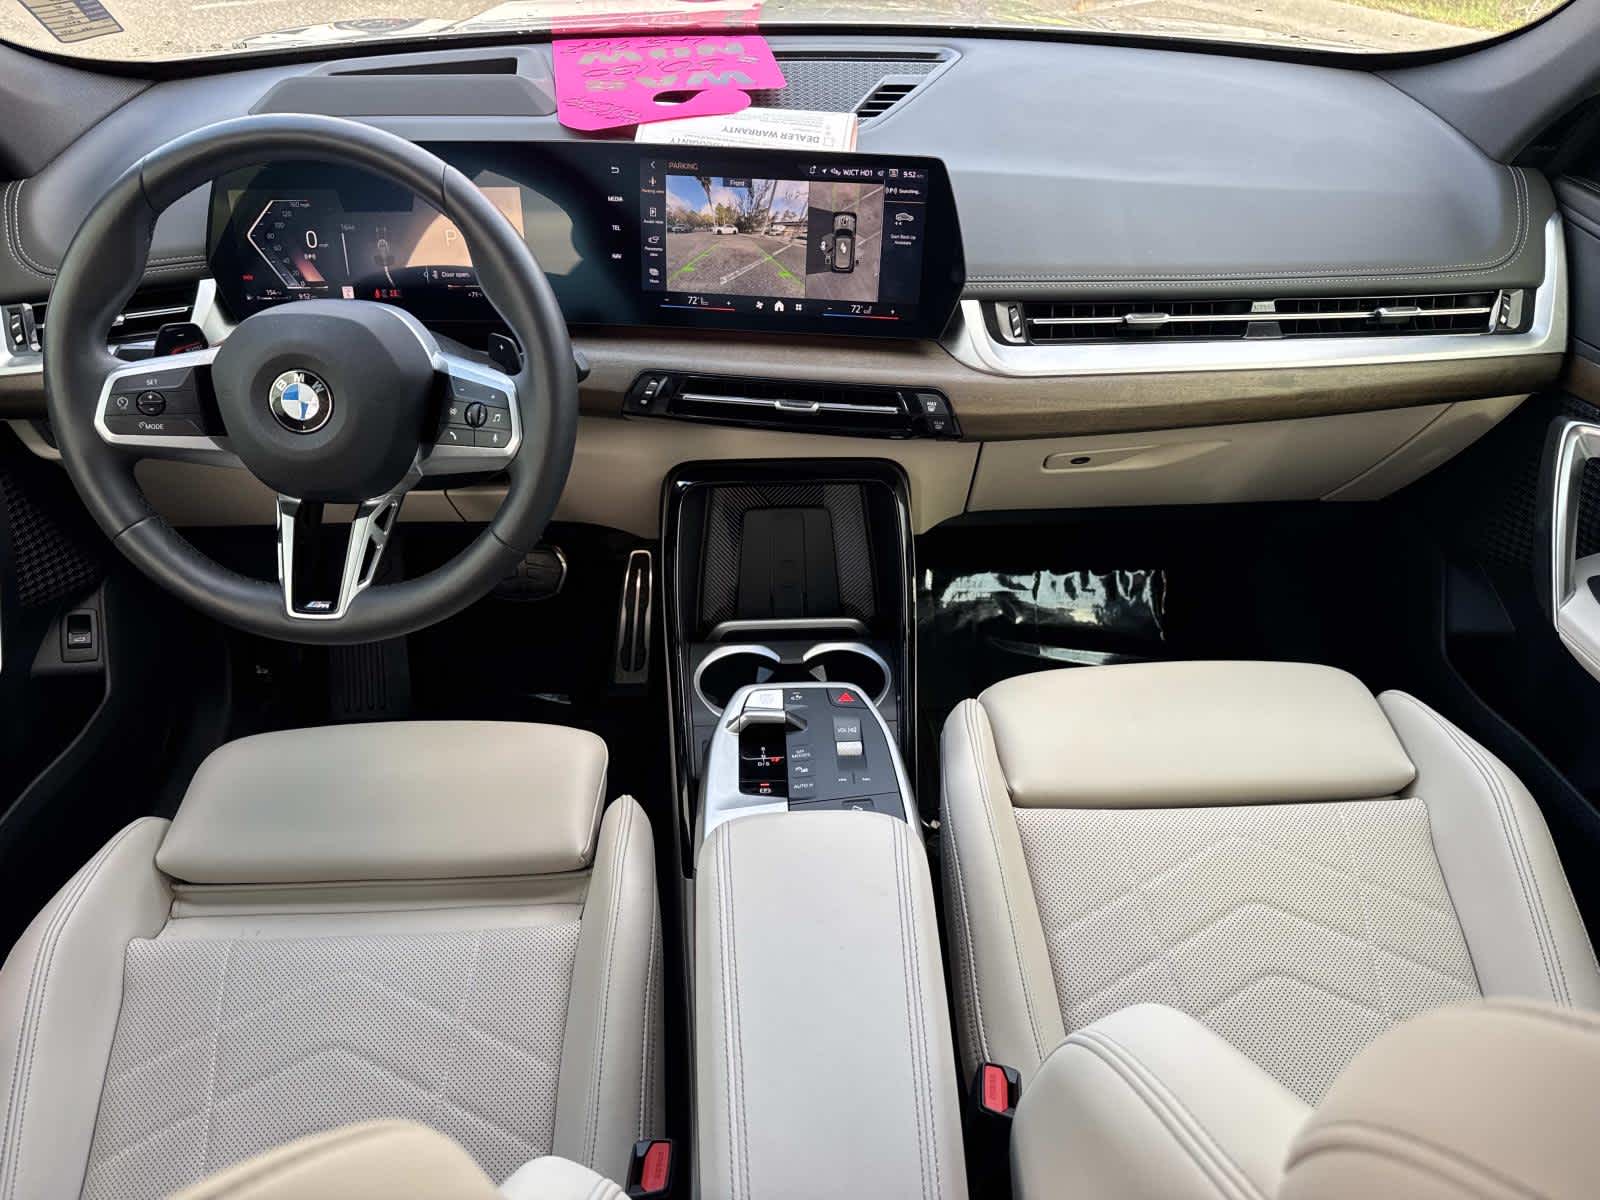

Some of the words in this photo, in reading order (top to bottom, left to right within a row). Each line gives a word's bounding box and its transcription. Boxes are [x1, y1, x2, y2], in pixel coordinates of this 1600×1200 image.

[584, 71, 757, 92] WAS
[721, 124, 778, 140] WARRANTY
[780, 131, 820, 144] DEALER
[669, 162, 698, 170] PARKING
[305, 230, 318, 249] 0
[446, 230, 457, 247] P
[274, 371, 326, 394] BMW
